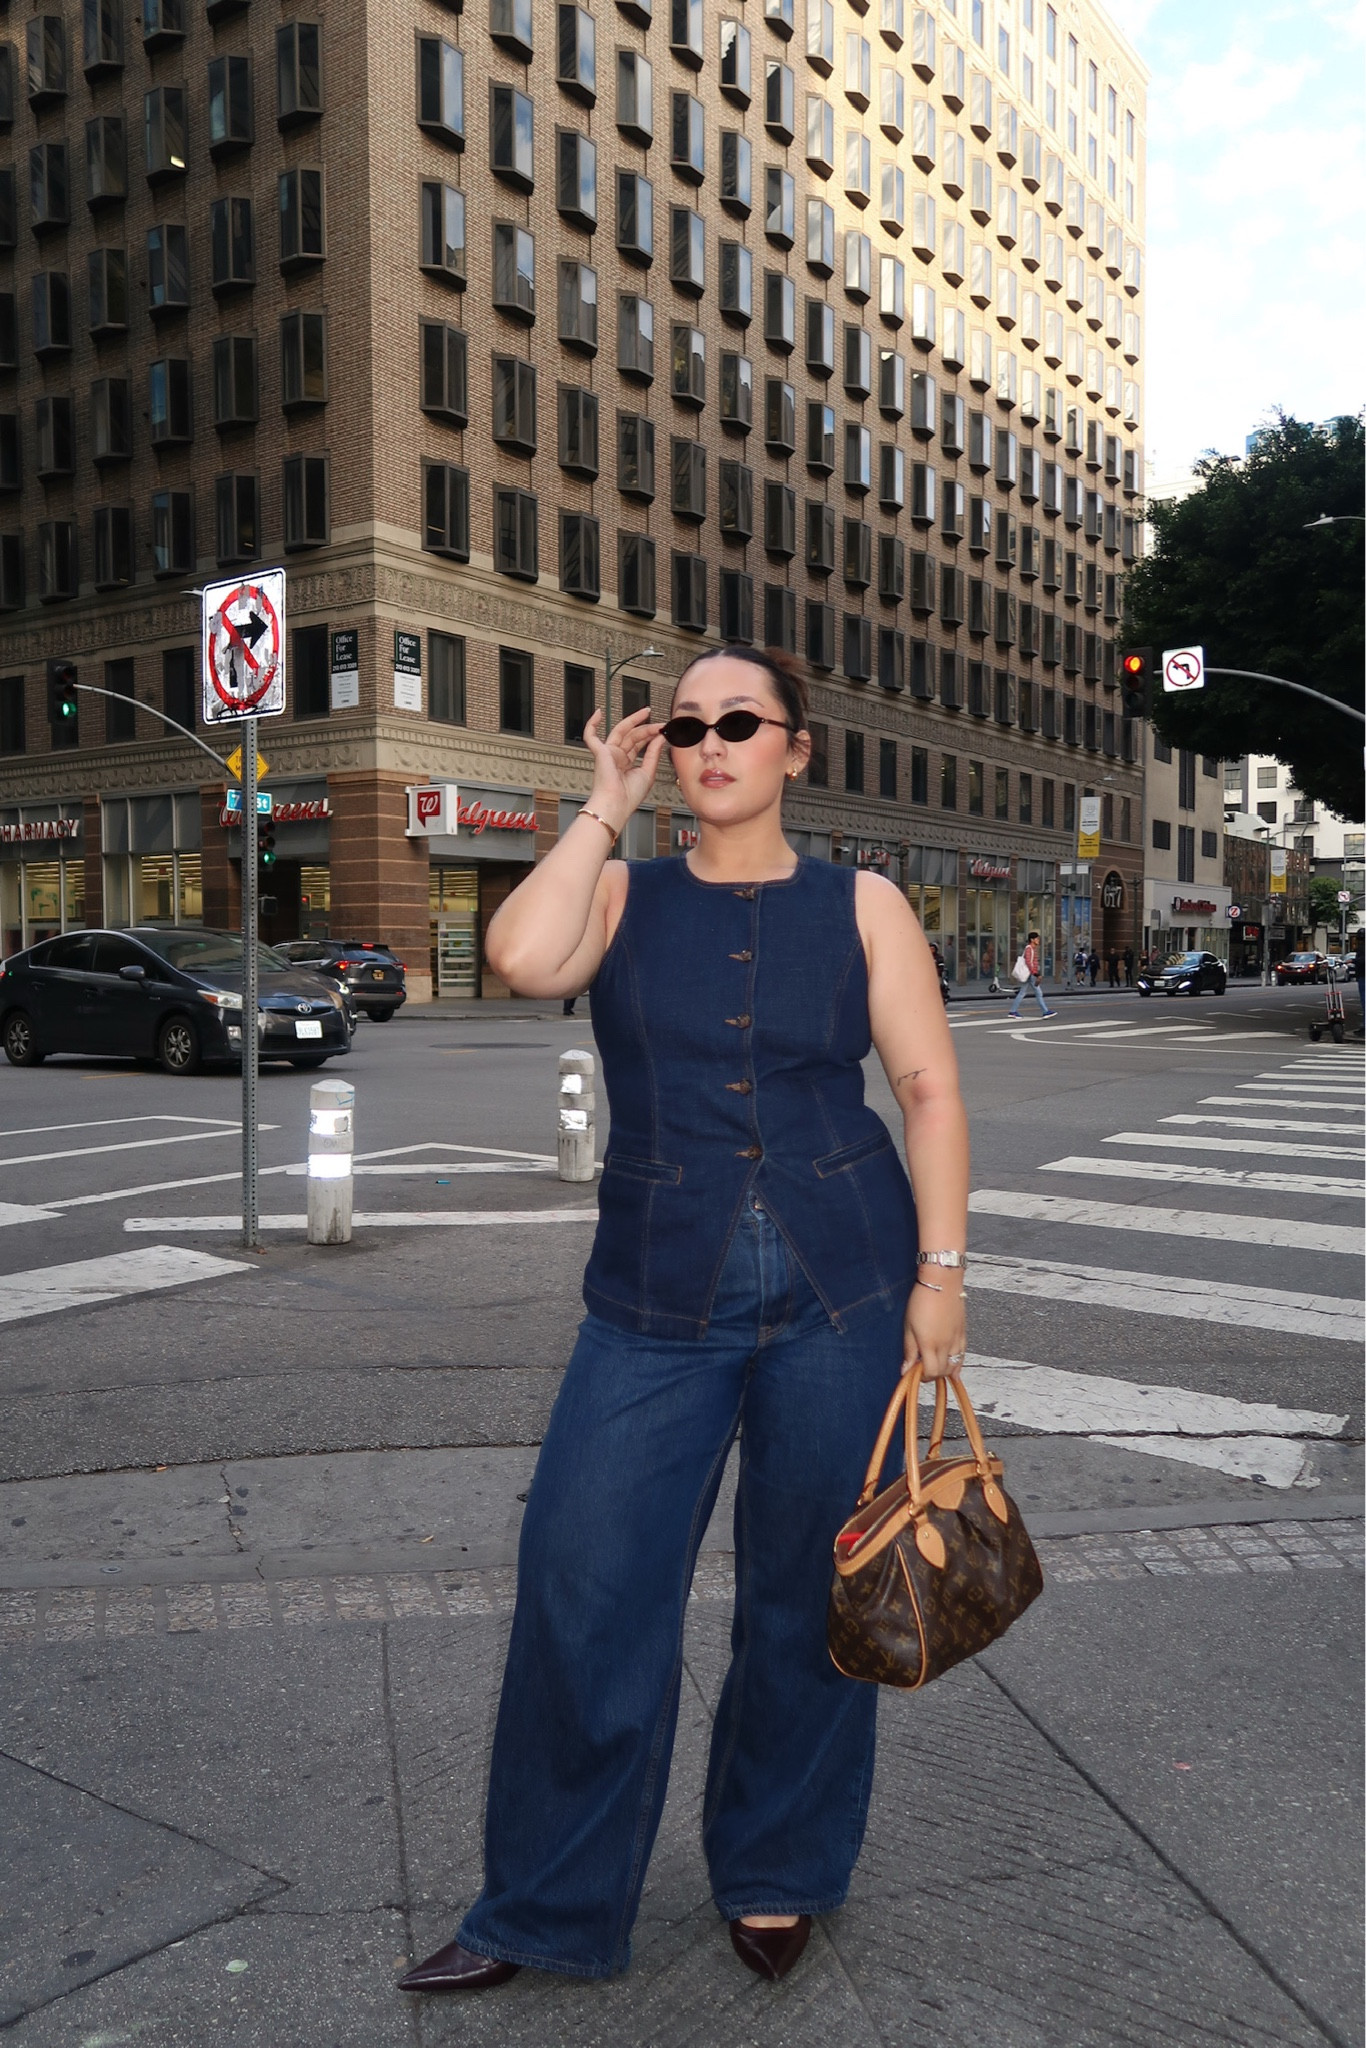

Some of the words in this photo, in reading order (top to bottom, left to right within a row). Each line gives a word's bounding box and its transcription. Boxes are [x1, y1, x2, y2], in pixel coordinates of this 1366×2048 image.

[335, 635, 353, 644] Office
[398, 636, 416, 647] Office
[335, 644, 346, 653] For
[398, 644, 410, 654] For
[335, 653, 353, 661] Lease
[399, 653, 416, 664] Lease
[216, 798, 333, 827] Wreens
[457, 796, 540, 835] algreens
[0, 819, 79, 842] HARMACY
[1103, 884, 1122, 908] 617
